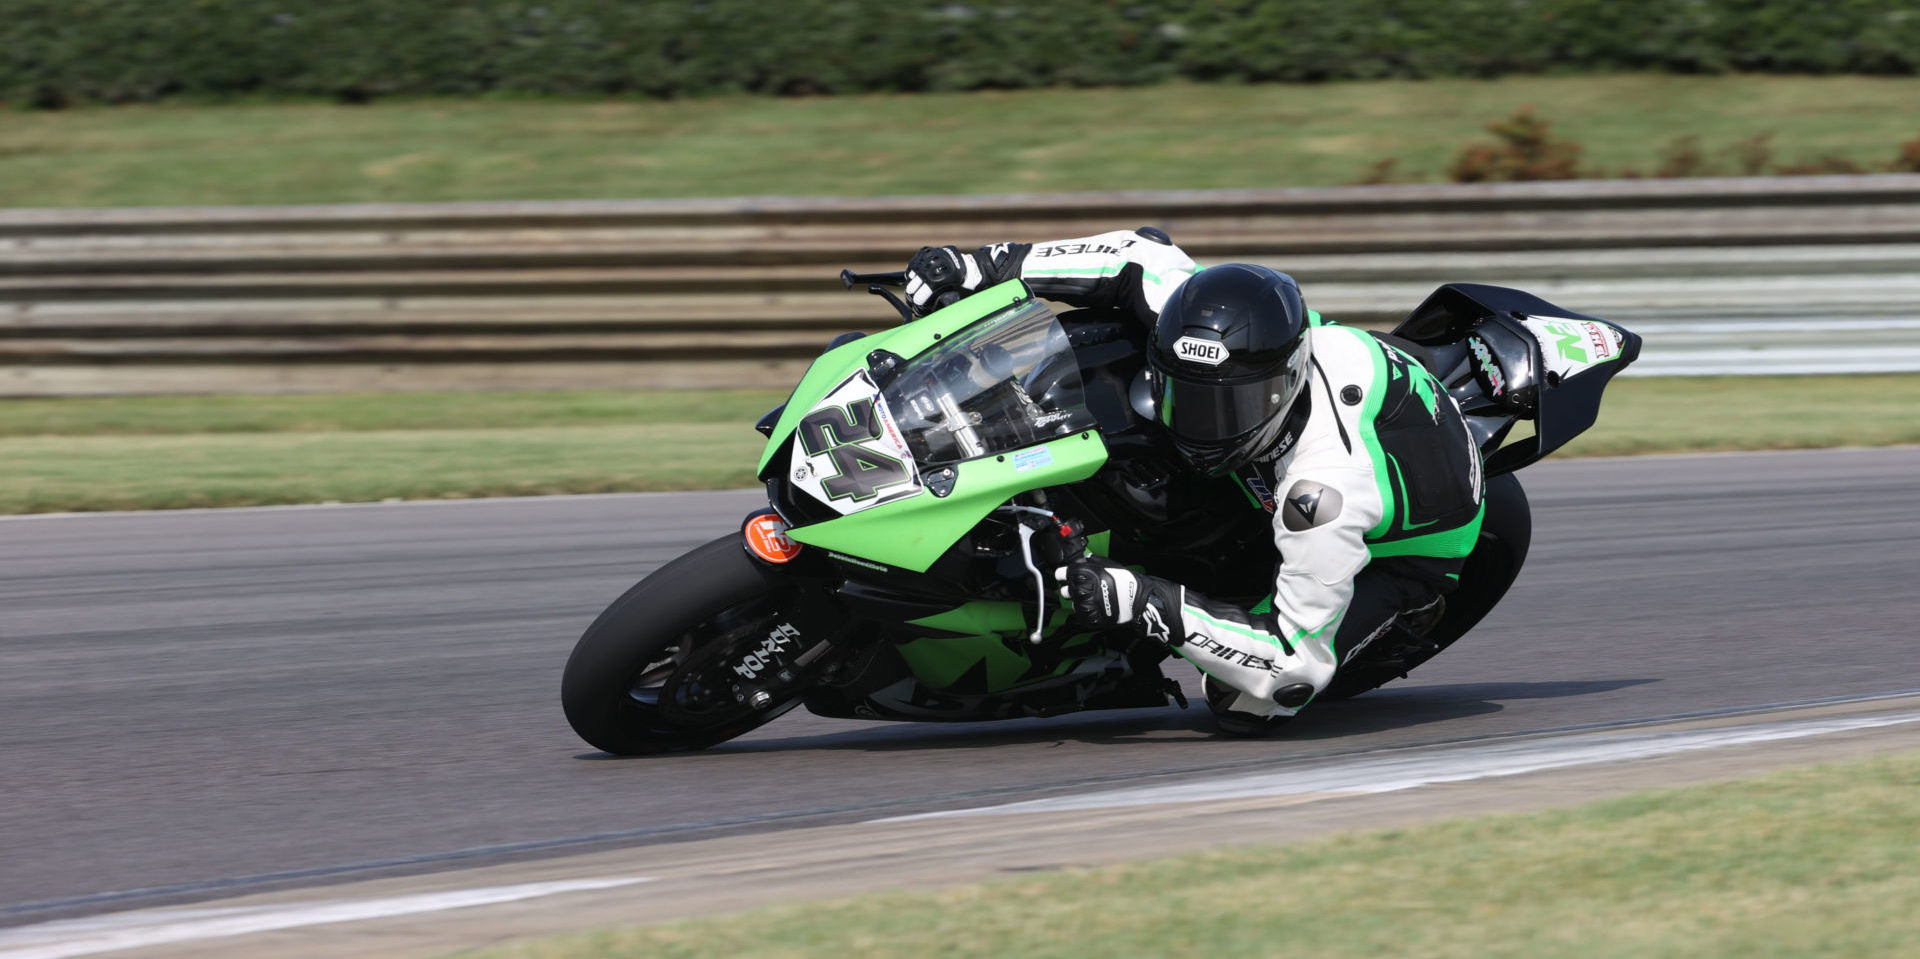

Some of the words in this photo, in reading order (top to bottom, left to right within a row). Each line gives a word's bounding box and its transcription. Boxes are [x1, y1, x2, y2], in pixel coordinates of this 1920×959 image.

[1180, 341, 1220, 361] SHOEI
[798, 397, 912, 504] 24
[1254, 431, 1294, 464] INESE
[733, 622, 801, 680] DUNLOP
[1185, 631, 1284, 679] DAINESE
